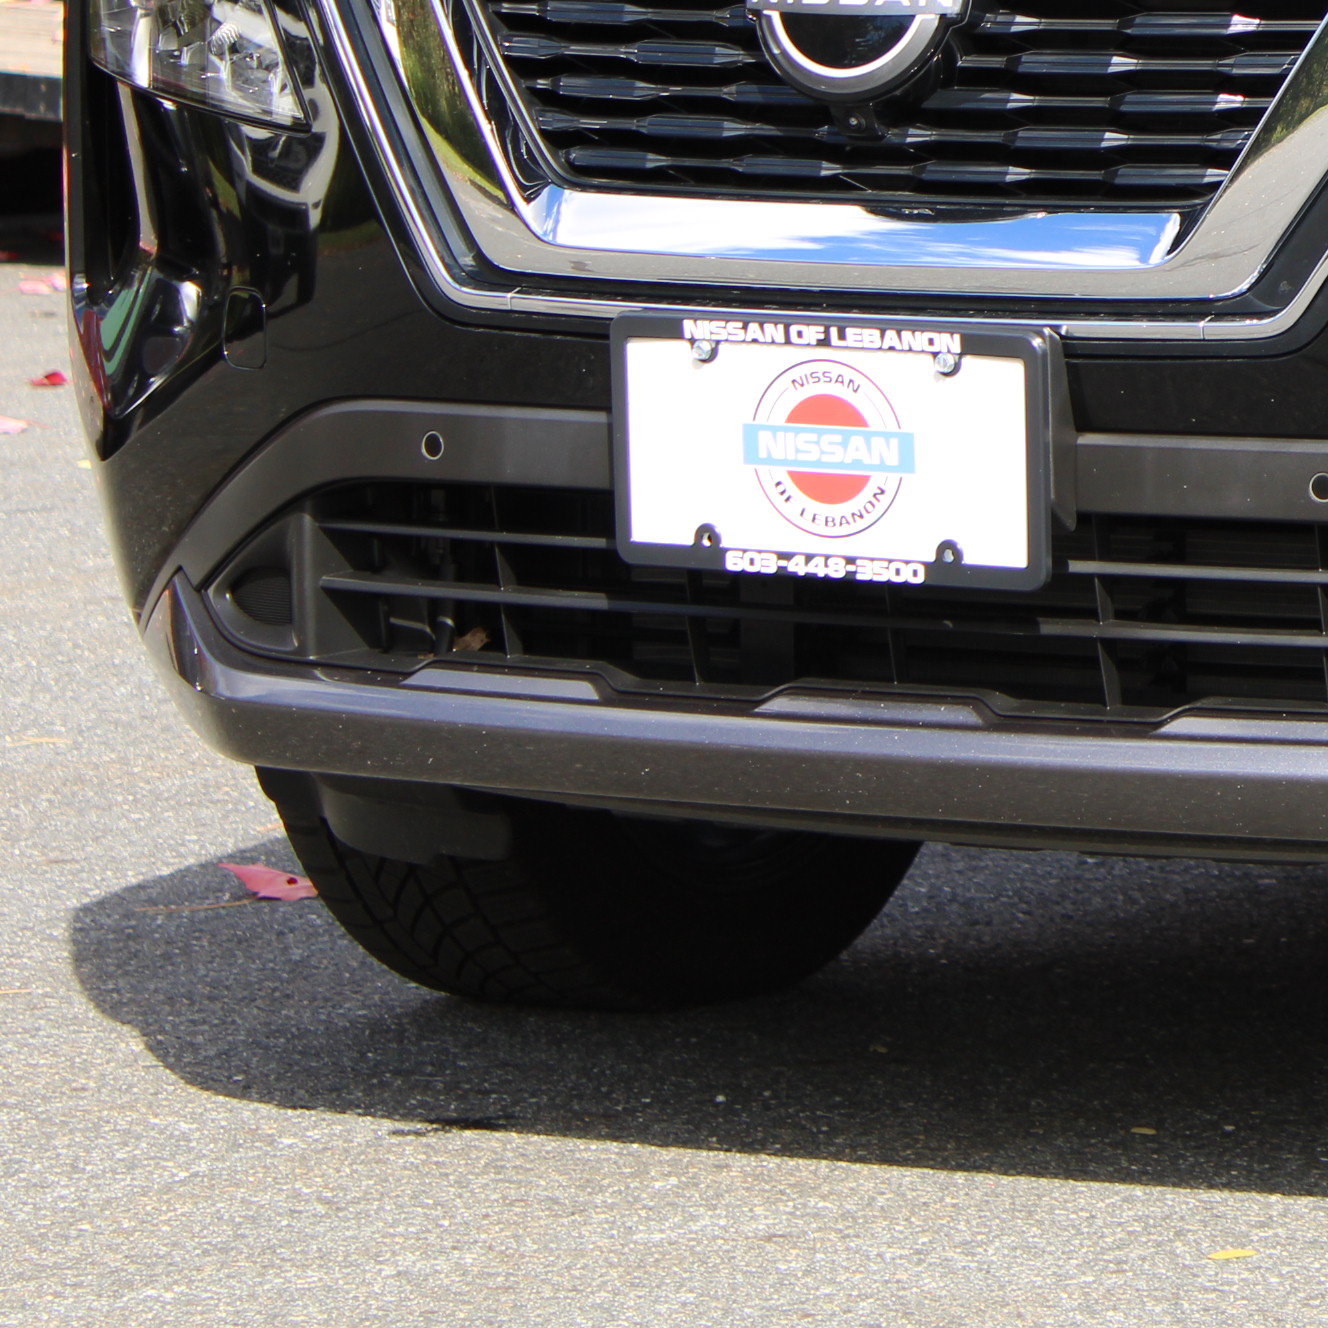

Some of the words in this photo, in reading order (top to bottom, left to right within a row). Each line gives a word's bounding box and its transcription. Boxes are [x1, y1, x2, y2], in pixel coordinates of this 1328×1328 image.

[683, 319, 784, 344] NISSAN
[789, 324, 826, 346] OF
[829, 327, 961, 354] LEBANON
[791, 371, 861, 393] NISSAN
[757, 429, 900, 467] NISSAN
[774, 480, 794, 504] OF
[799, 485, 887, 528] LEBANON
[724, 549, 926, 585] 603-448-3500
